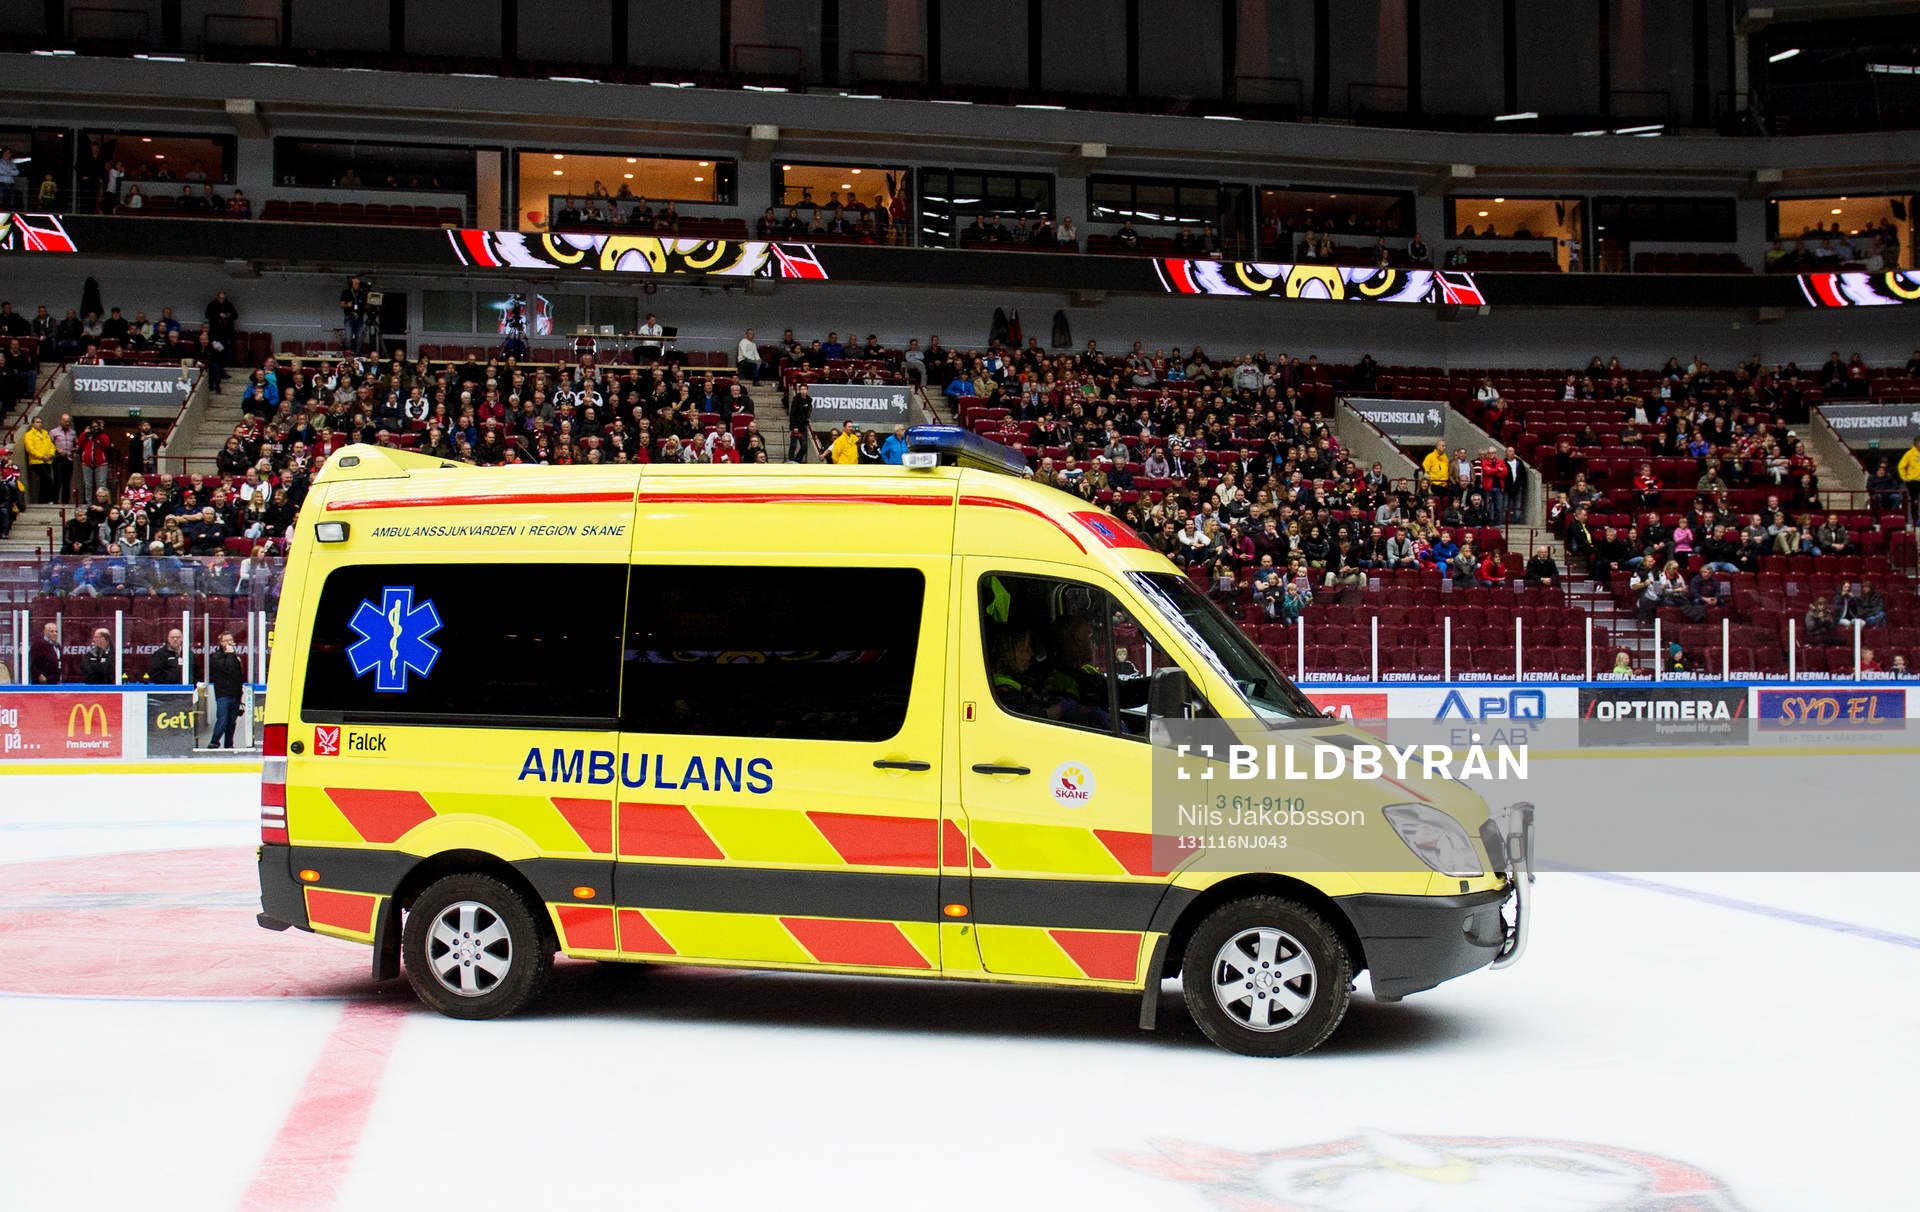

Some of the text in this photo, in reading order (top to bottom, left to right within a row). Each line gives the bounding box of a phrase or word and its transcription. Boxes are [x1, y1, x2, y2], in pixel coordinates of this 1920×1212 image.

[74, 379, 173, 394] SYDSVENSKAN
[812, 396, 889, 411] YDSVENSKAN
[1827, 415, 1908, 429] YDSVENSKAN
[519, 525, 526, 536] I
[528, 525, 578, 536] REGION
[1305, 672, 1343, 682] KERMA
[1345, 674, 1370, 682] Kakel
[1382, 672, 1416, 682] KERMA
[1458, 672, 1492, 681] KERMA
[1523, 672, 1560, 681] KERMA
[1662, 671, 1697, 681] KERMA
[1730, 671, 1765, 681] KERMA
[1796, 671, 1830, 681] KERMA
[1861, 671, 1896, 681] KERMA
[0, 705, 18, 729] ag
[1596, 700, 1732, 722] OPTIMERA
[1779, 696, 1886, 726] SYD EL
[348, 732, 387, 752] Falck
[1488, 728, 1529, 746] AB
[518, 747, 774, 795] AMBULANS
[1216, 794, 1306, 812] 3 61-9110
